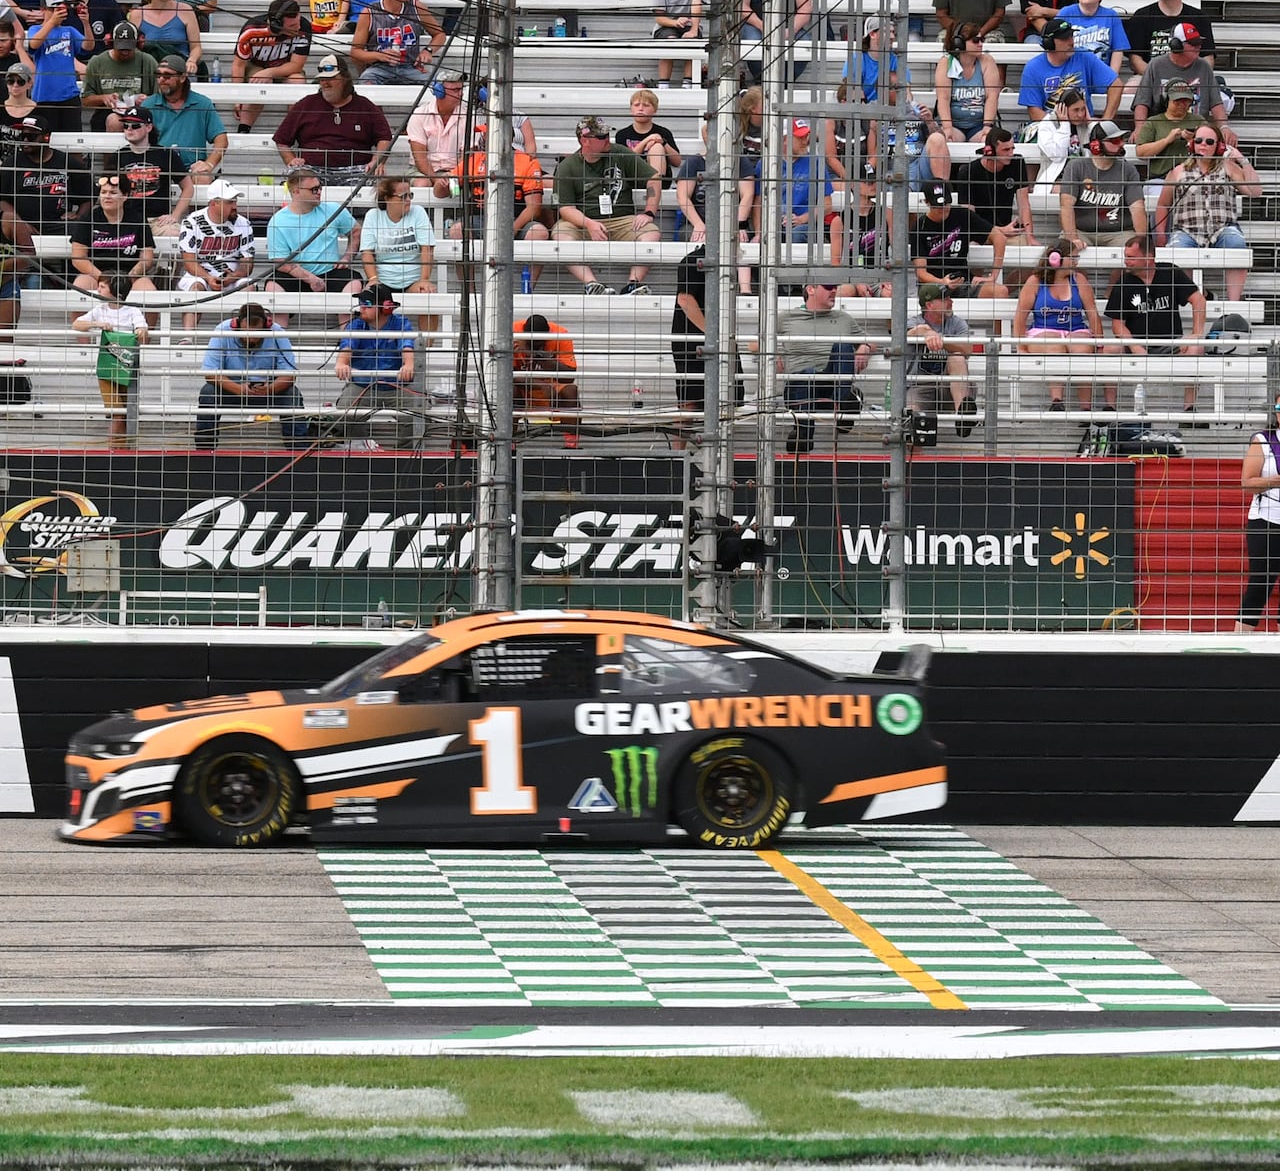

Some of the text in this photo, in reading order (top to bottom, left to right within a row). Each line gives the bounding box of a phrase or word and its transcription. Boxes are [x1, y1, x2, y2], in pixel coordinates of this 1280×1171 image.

[376, 24, 416, 46] USA
[45, 40, 70, 54] LARSON
[253, 39, 293, 61] TRUE
[1079, 188, 1122, 207] HARVICK
[1106, 207, 1119, 221] 4
[949, 239, 961, 252] 48
[20, 512, 118, 534] QUAKER
[155, 497, 518, 573] QUAKE
[842, 524, 1040, 566] Walmart
[470, 706, 538, 815] 1
